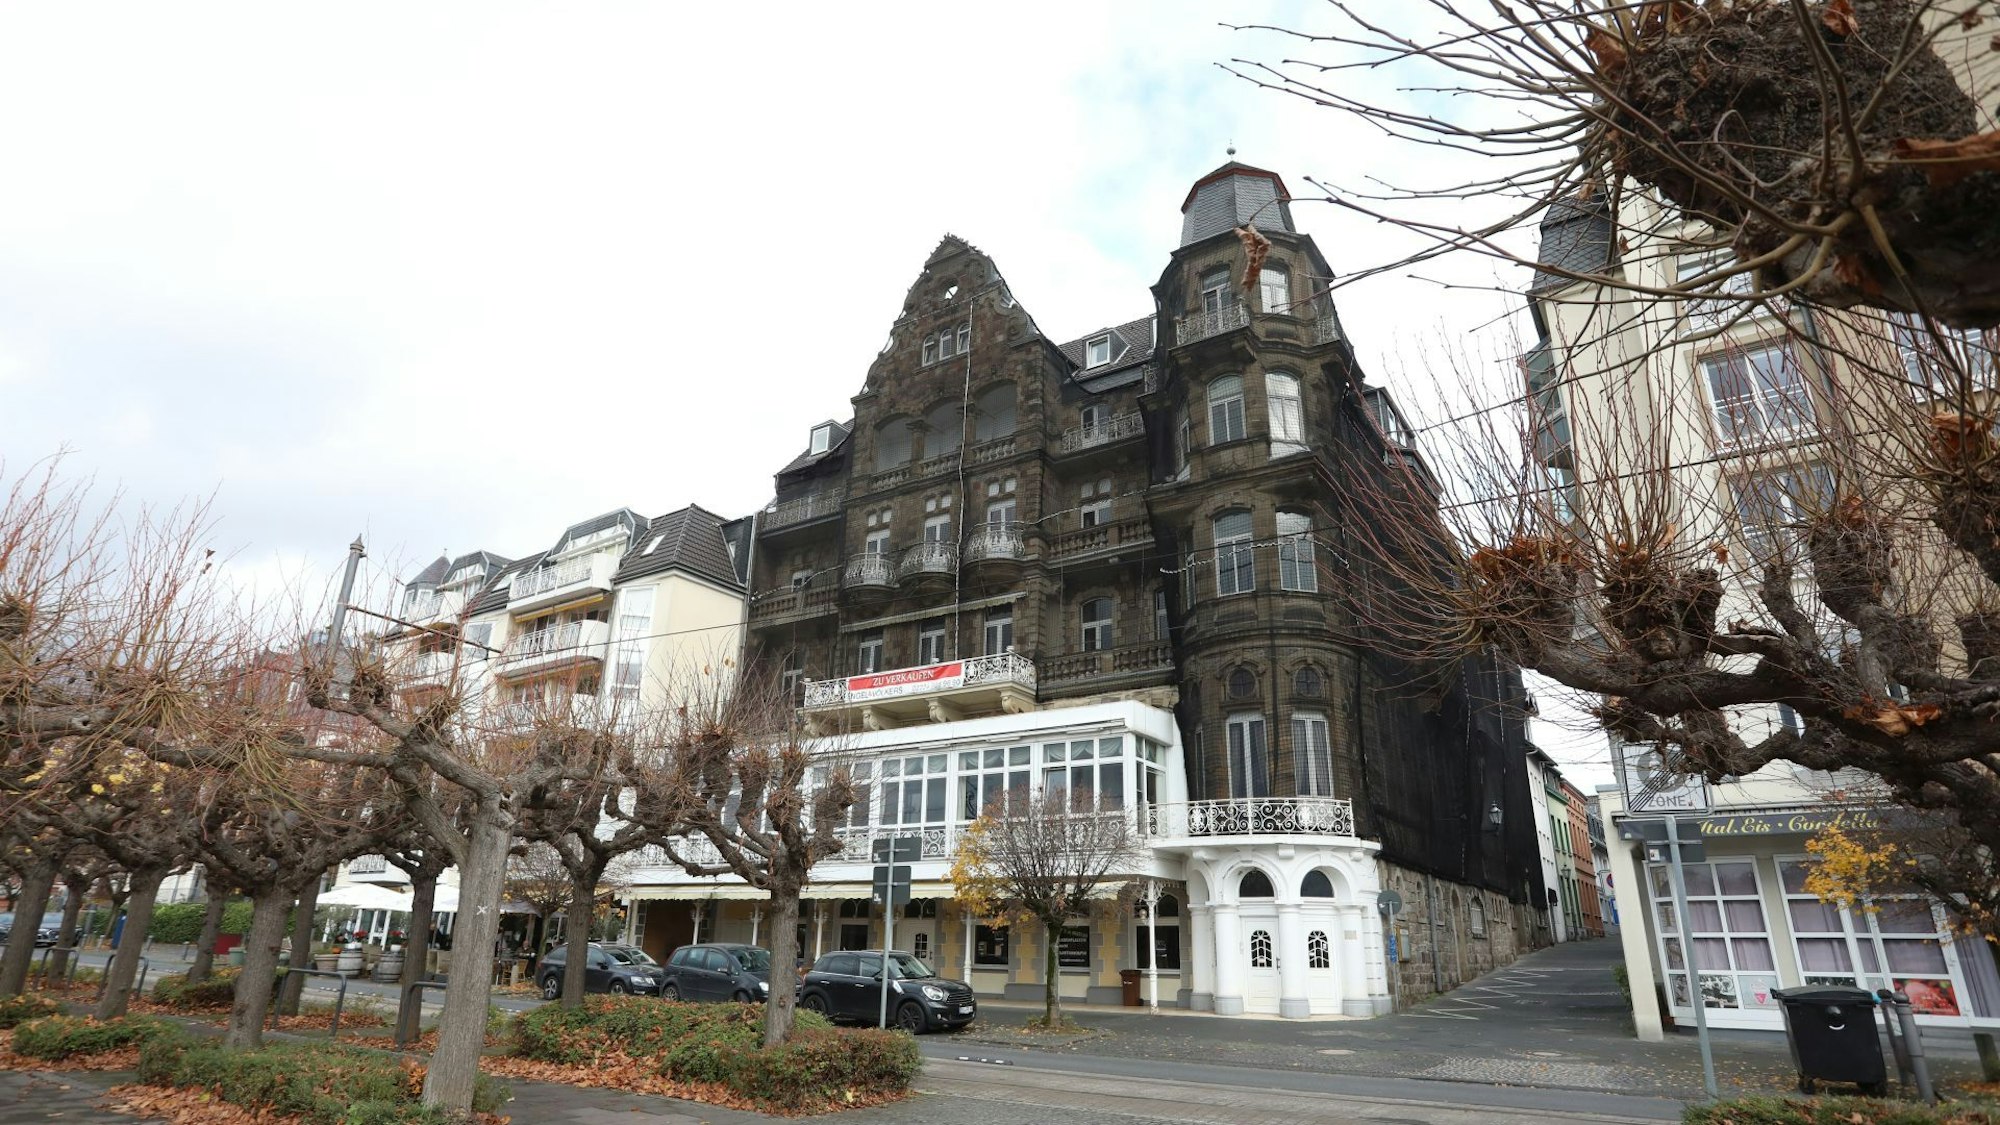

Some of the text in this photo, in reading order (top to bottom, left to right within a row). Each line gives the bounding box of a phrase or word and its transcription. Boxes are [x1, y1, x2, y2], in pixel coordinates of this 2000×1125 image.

[873, 670, 934, 687] ZU VERKAUFEN
[1648, 795, 1687, 807] ZONE
[1741, 817, 1771, 833] Eis
